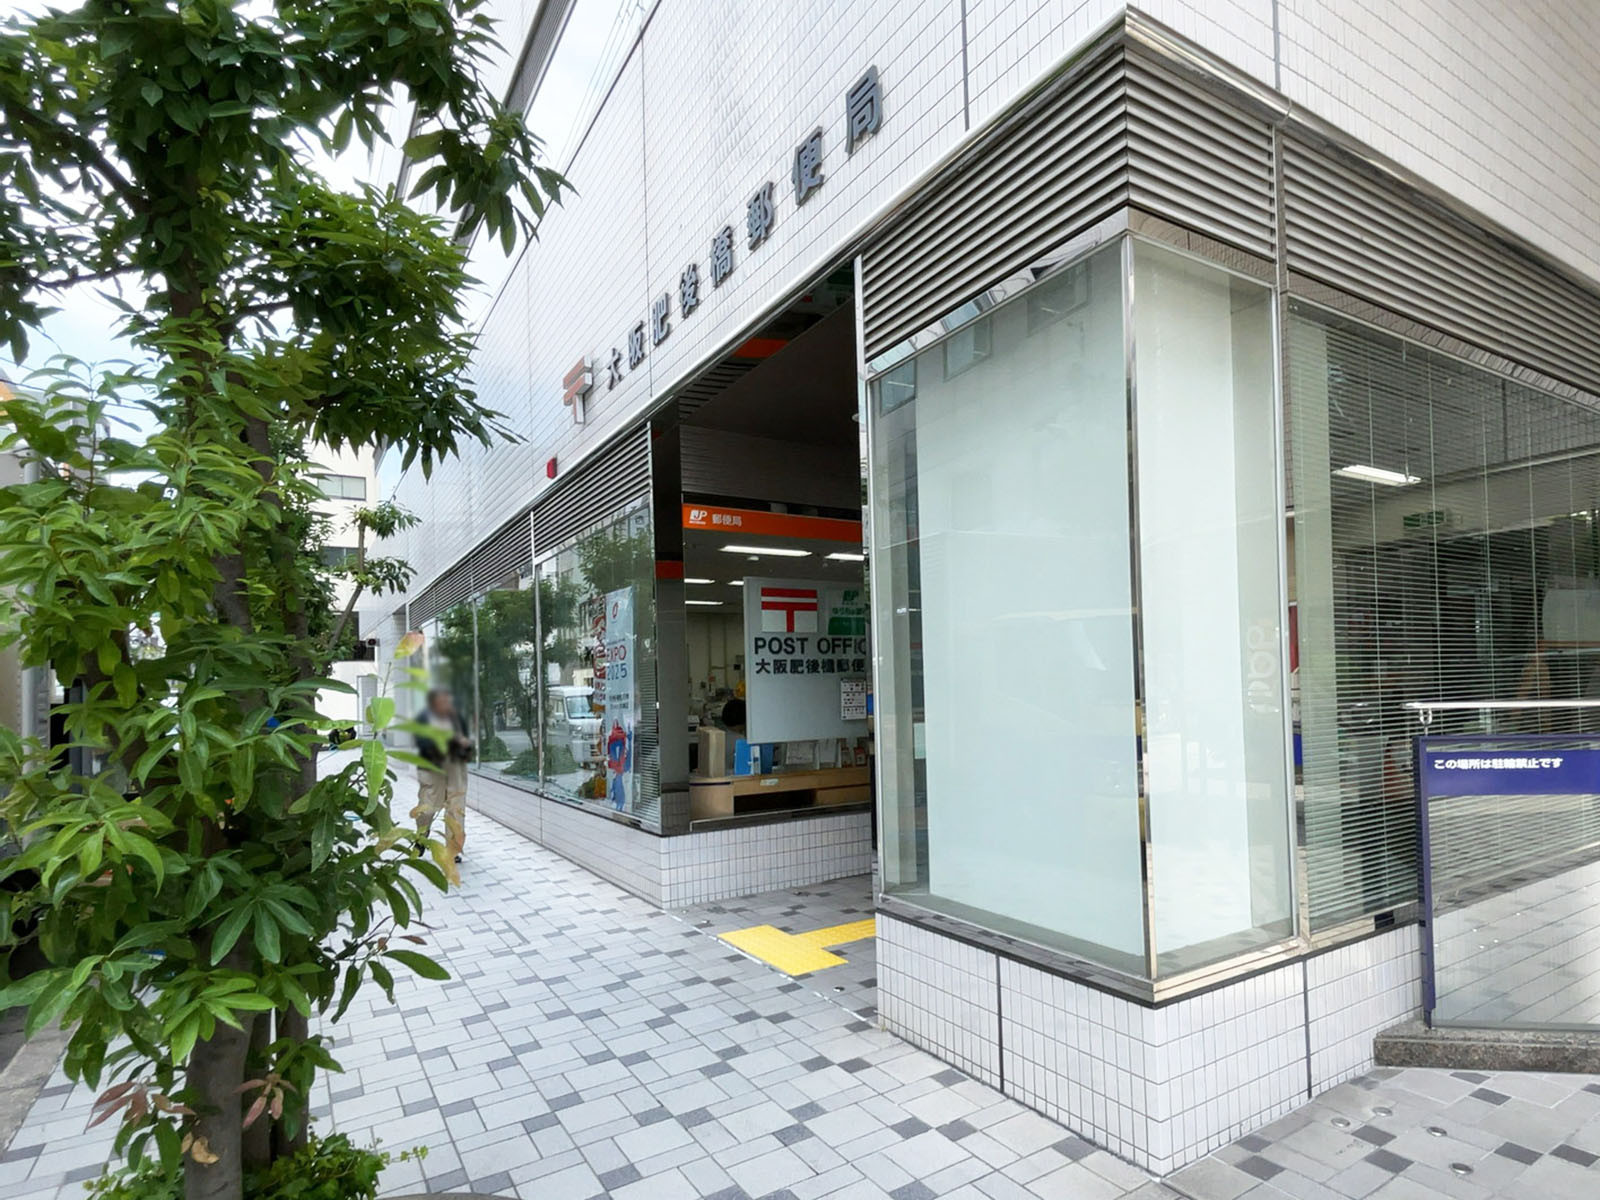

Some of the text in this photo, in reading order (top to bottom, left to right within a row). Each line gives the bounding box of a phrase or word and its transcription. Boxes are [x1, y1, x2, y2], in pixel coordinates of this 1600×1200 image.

[608, 65, 883, 391] 大阪肥後橋郵便局
[712, 514, 742, 527] 郵便局
[754, 637, 808, 655] POST
